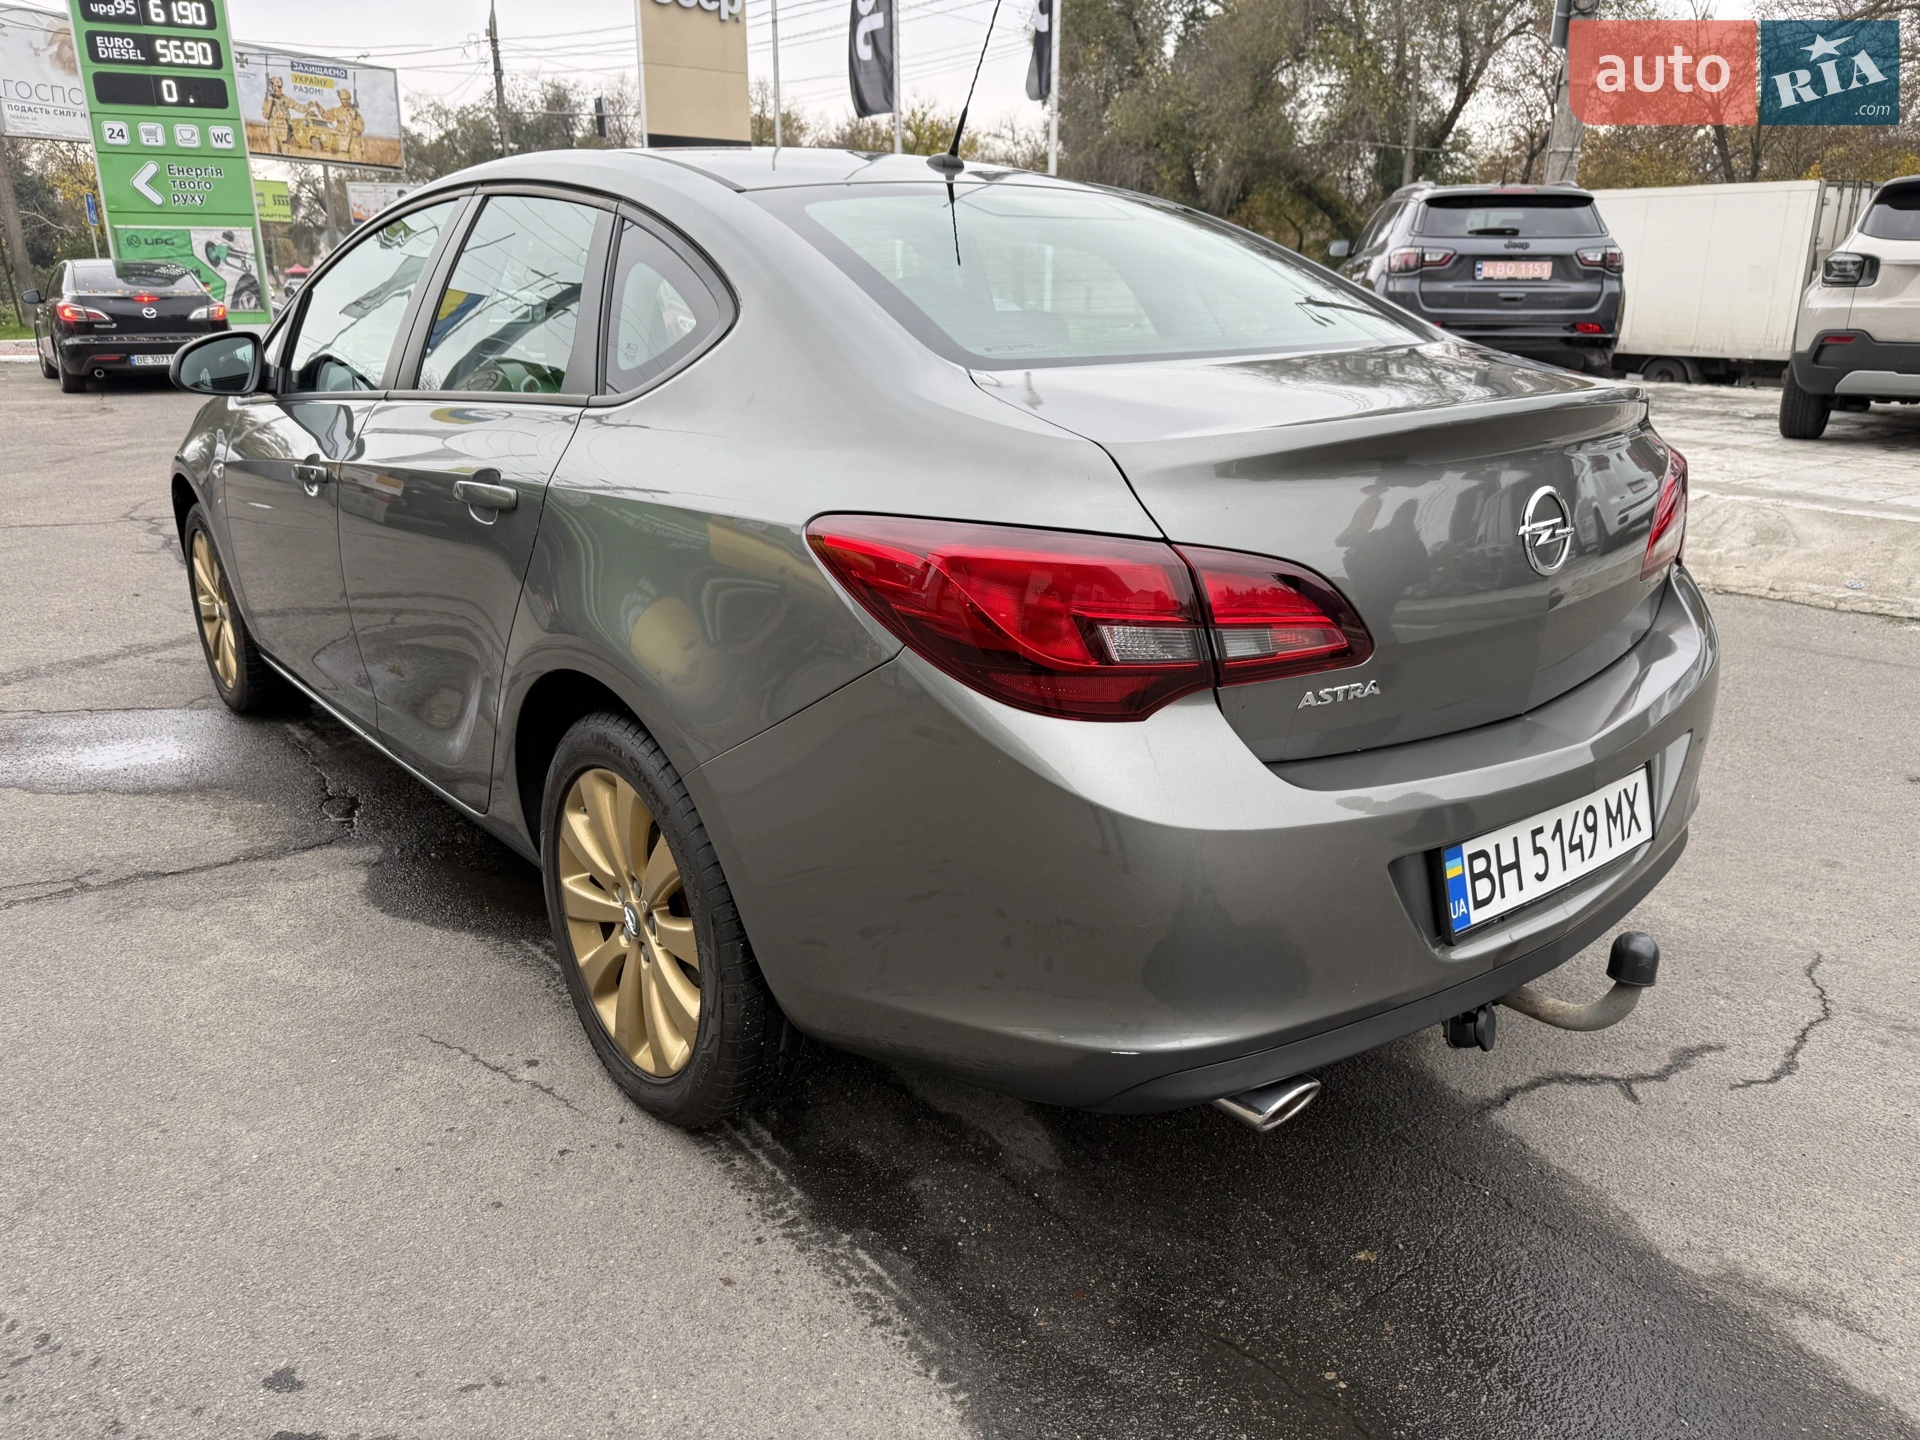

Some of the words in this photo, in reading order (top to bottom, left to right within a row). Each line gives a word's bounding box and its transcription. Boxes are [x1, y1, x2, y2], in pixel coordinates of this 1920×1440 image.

[90, 0, 136, 15] upg95
[96, 36, 134, 48] EURO
[98, 47, 145, 60] DIESEL
[155, 40, 213, 65] 56.90
[292, 62, 346, 77] ЗАХИЩАЄМО
[293, 74, 328, 87] УКРАЇНУ
[293, 85, 324, 96] РАЗОМ!
[7, 104, 50, 115] ПОДАСТЬ
[53, 109, 77, 118] СИЛУ
[107, 128, 125, 139] 24
[212, 132, 231, 144] WC
[167, 164, 223, 179] Енергія
[170, 180, 212, 190] твого
[172, 193, 205, 205] руху
[144, 238, 175, 246] UPG
[1504, 240, 1530, 250] Jeep
[1520, 262, 1548, 276] 1151
[1297, 680, 1380, 709] ASTRA
[1467, 835, 1523, 911] BH
[1530, 804, 1598, 882] 5149
[1604, 782, 1642, 848] MX
[1450, 898, 1467, 919] UA
